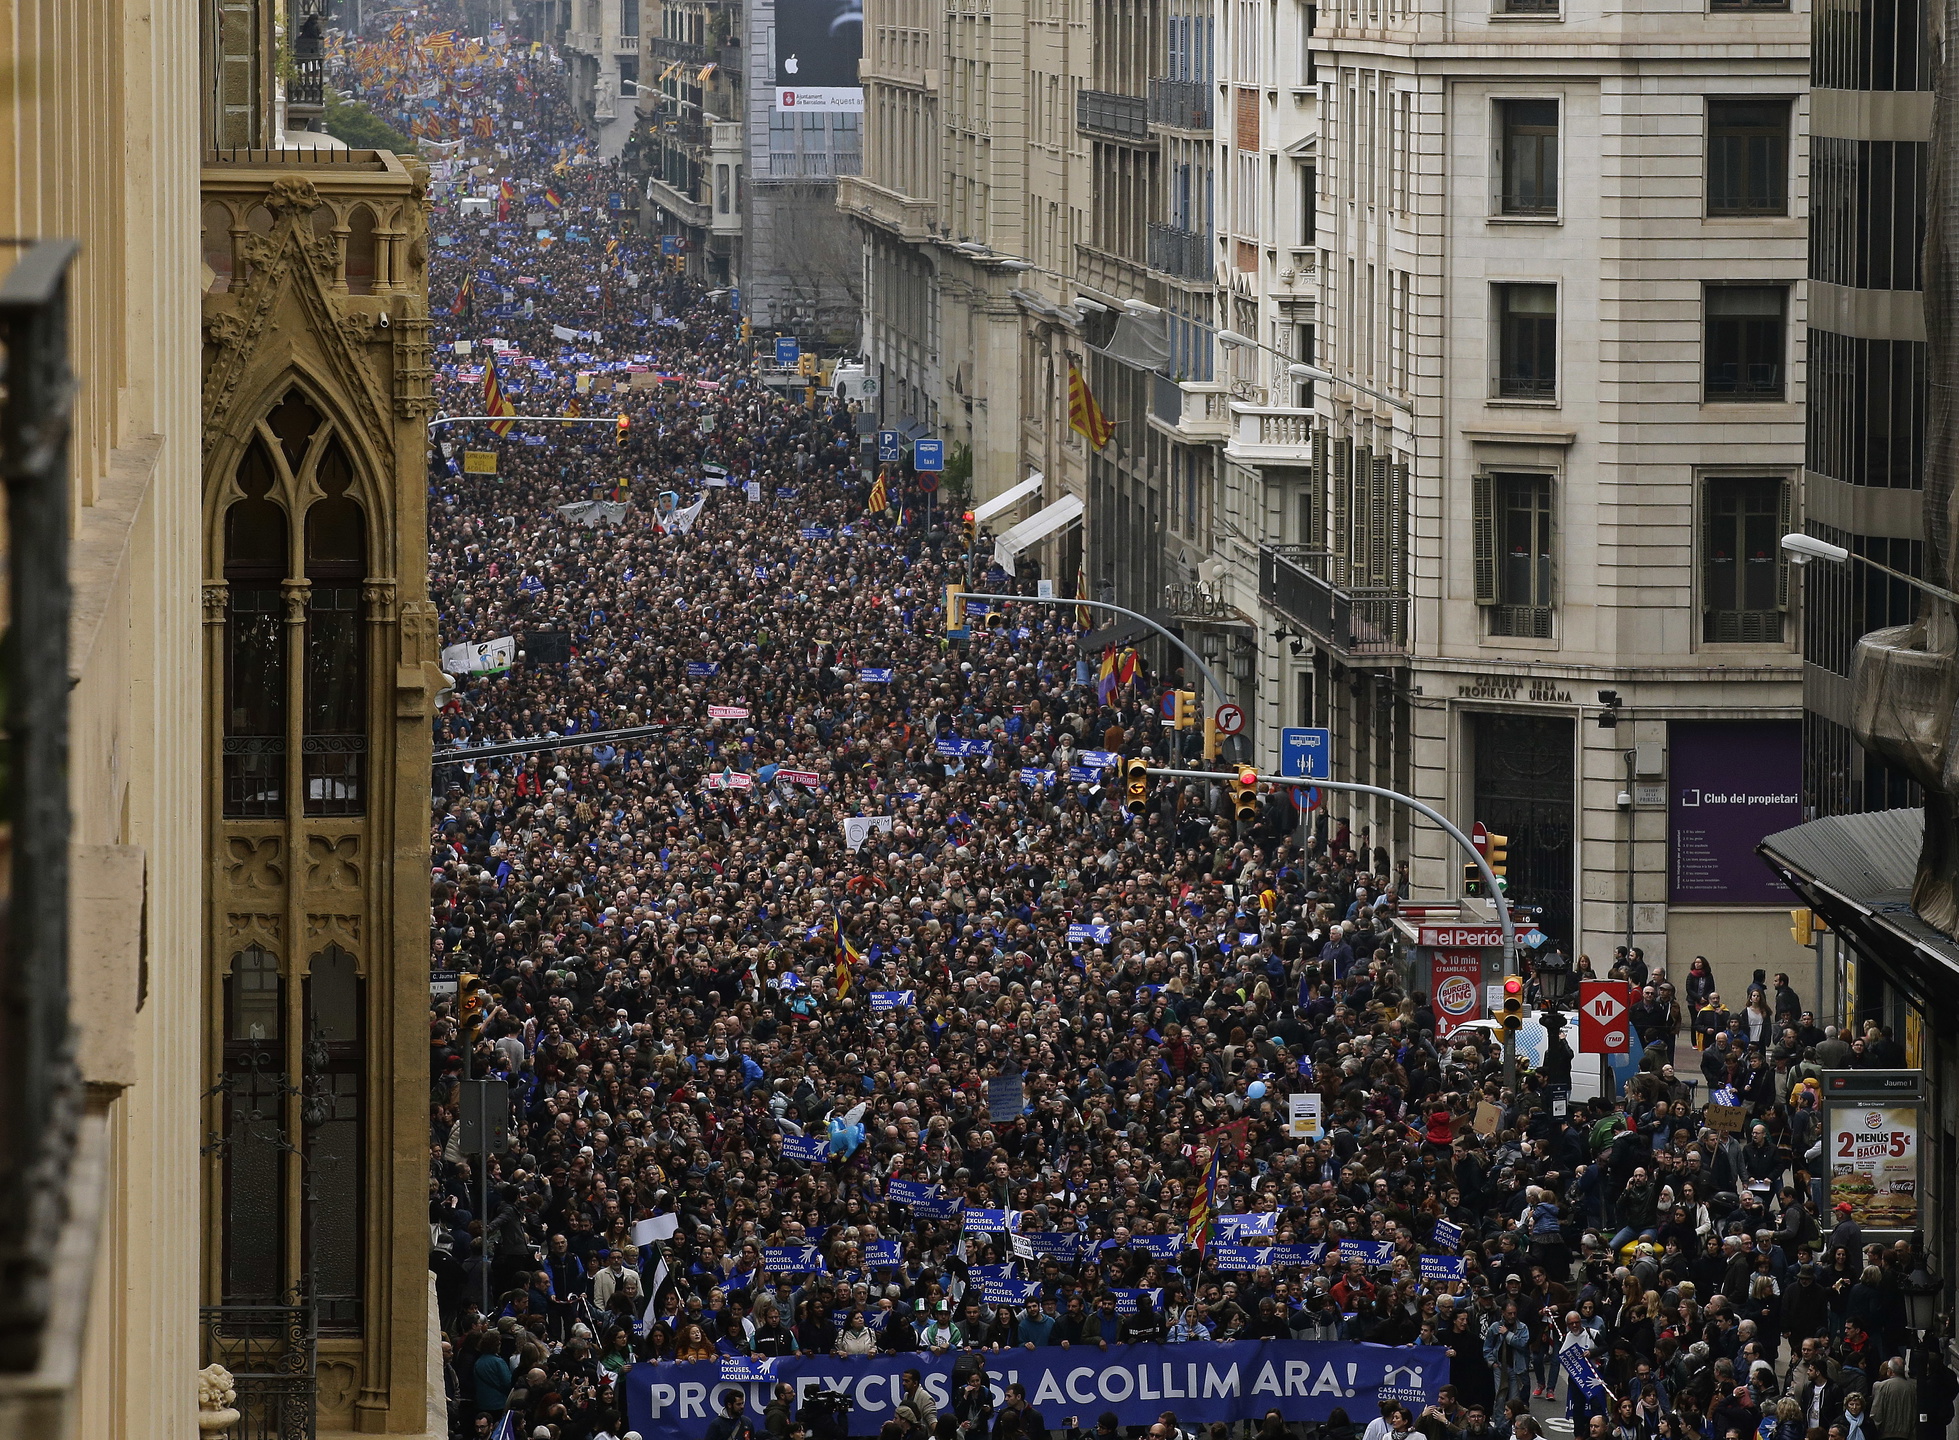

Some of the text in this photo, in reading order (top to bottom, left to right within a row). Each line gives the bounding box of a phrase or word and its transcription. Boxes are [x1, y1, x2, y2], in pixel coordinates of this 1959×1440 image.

[885, 434, 892, 444] P
[1475, 676, 1556, 690] CAMBRA DE LA
[1459, 685, 1572, 702] PROPIETAT URBANA
[1704, 793, 1798, 806] Club del propietari
[1438, 930, 1453, 945] el
[1449, 956, 1479, 965] 10 min.
[1443, 983, 1470, 996] BURGER
[1444, 990, 1471, 1006] KING
[1596, 1001, 1613, 1016] M
[1838, 1132, 1854, 1157] 2
[1856, 1132, 1889, 1143] MENÚS
[783, 1144, 807, 1153] EXCUSES,
[1857, 1144, 1887, 1158] BACON
[890, 1188, 916, 1198] EXCUSES,
[1437, 1223, 1453, 1233] PROU
[984, 1288, 1014, 1296] EXCUSES,
[1571, 1346, 1583, 1360] PROU
[1565, 1350, 1584, 1375] EXCUSES,
[1559, 1355, 1577, 1377] ACOLLIM
[1574, 1376, 1585, 1389] ARA
[1032, 1362, 1241, 1405] ACOLLIM
[1251, 1360, 1357, 1398] ARA!
[1398, 1388, 1426, 1396] NOSTRA
